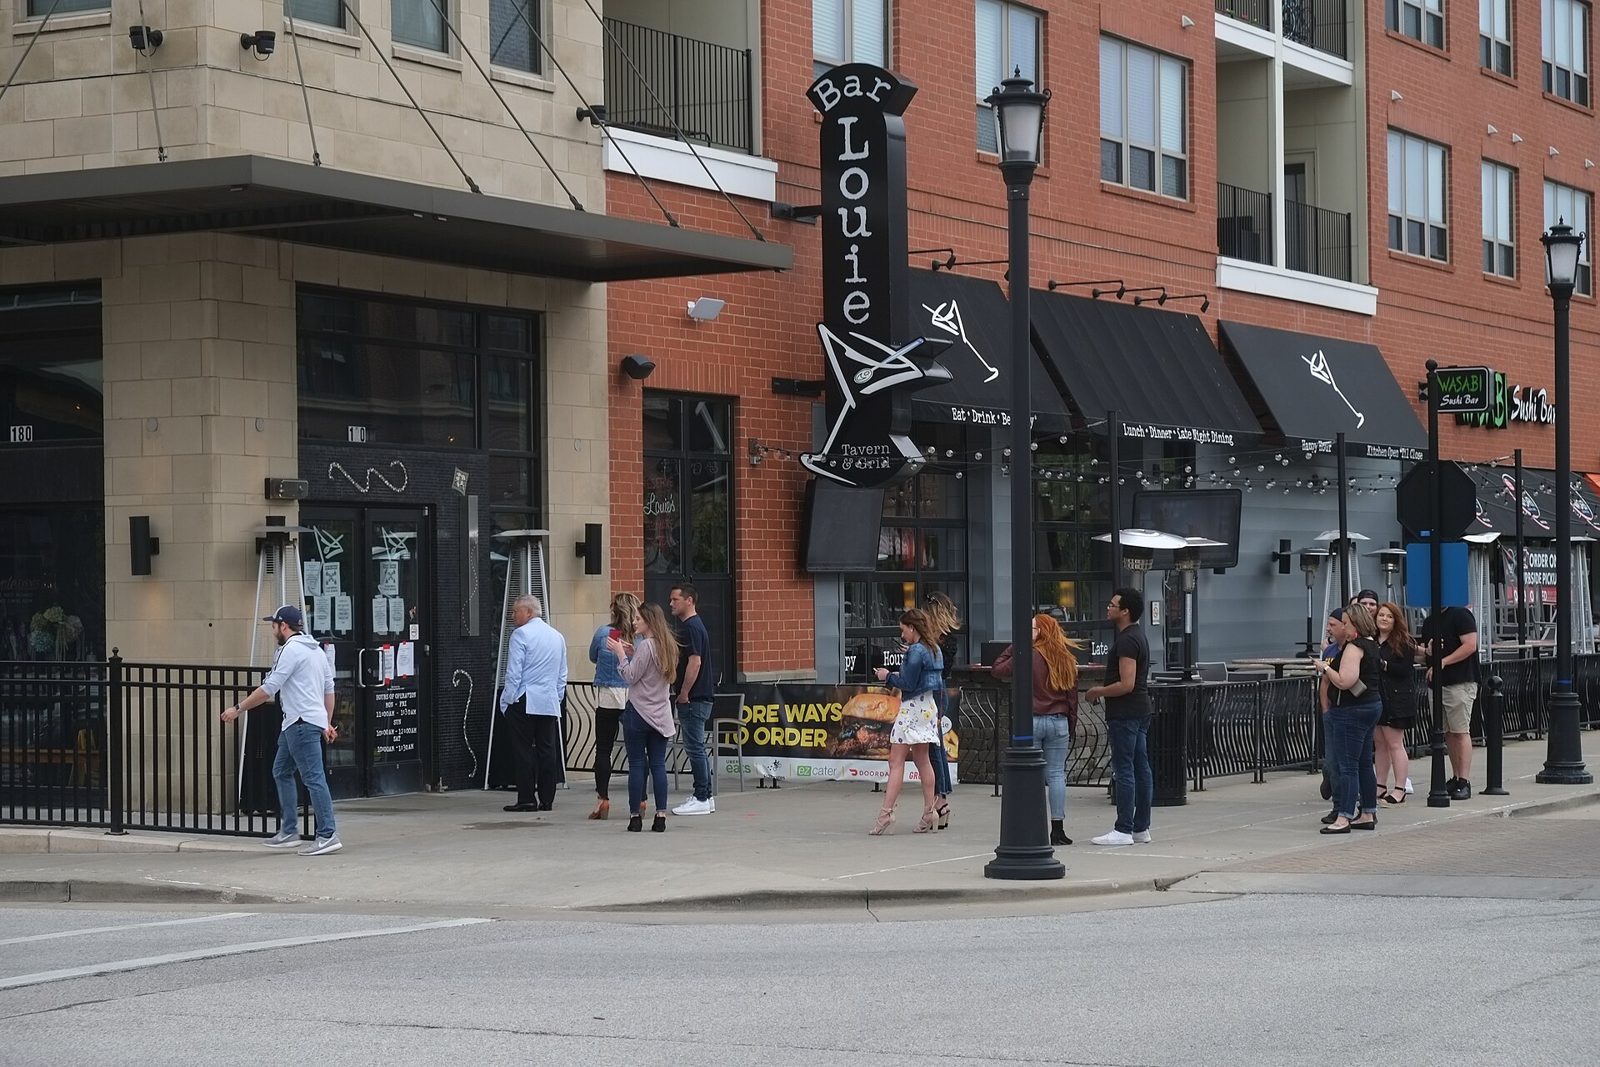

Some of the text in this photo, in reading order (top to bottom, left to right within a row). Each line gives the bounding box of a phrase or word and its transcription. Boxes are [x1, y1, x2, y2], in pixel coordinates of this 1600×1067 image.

[813, 75, 892, 112] Bar
[837, 116, 872, 325] Louie
[1436, 373, 1483, 392] WASABI
[1440, 393, 1479, 407] Sushi Bar
[1510, 384, 1537, 422] Sushi
[951, 407, 1011, 426] Eat Drink Be
[11, 426, 31, 442] 180
[1122, 422, 1234, 447] Lunch Dinner Late Night Dining
[841, 443, 891, 457] Tavern
[1366, 445, 1387, 458] Kitchen
[1387, 446, 1399, 460] Open
[1409, 448, 1424, 461] Close
[841, 456, 891, 470] & Grill
[643, 491, 676, 517] Louie's
[1529, 552, 1549, 568] ORDER
[1523, 571, 1557, 586] RBSIDE PICKU
[1091, 641, 1109, 656] Late
[741, 702, 842, 723] ORE WAYS
[753, 726, 828, 747] ORDER
[725, 763, 751, 773] eas
[859, 769, 889, 777] DOORDA
